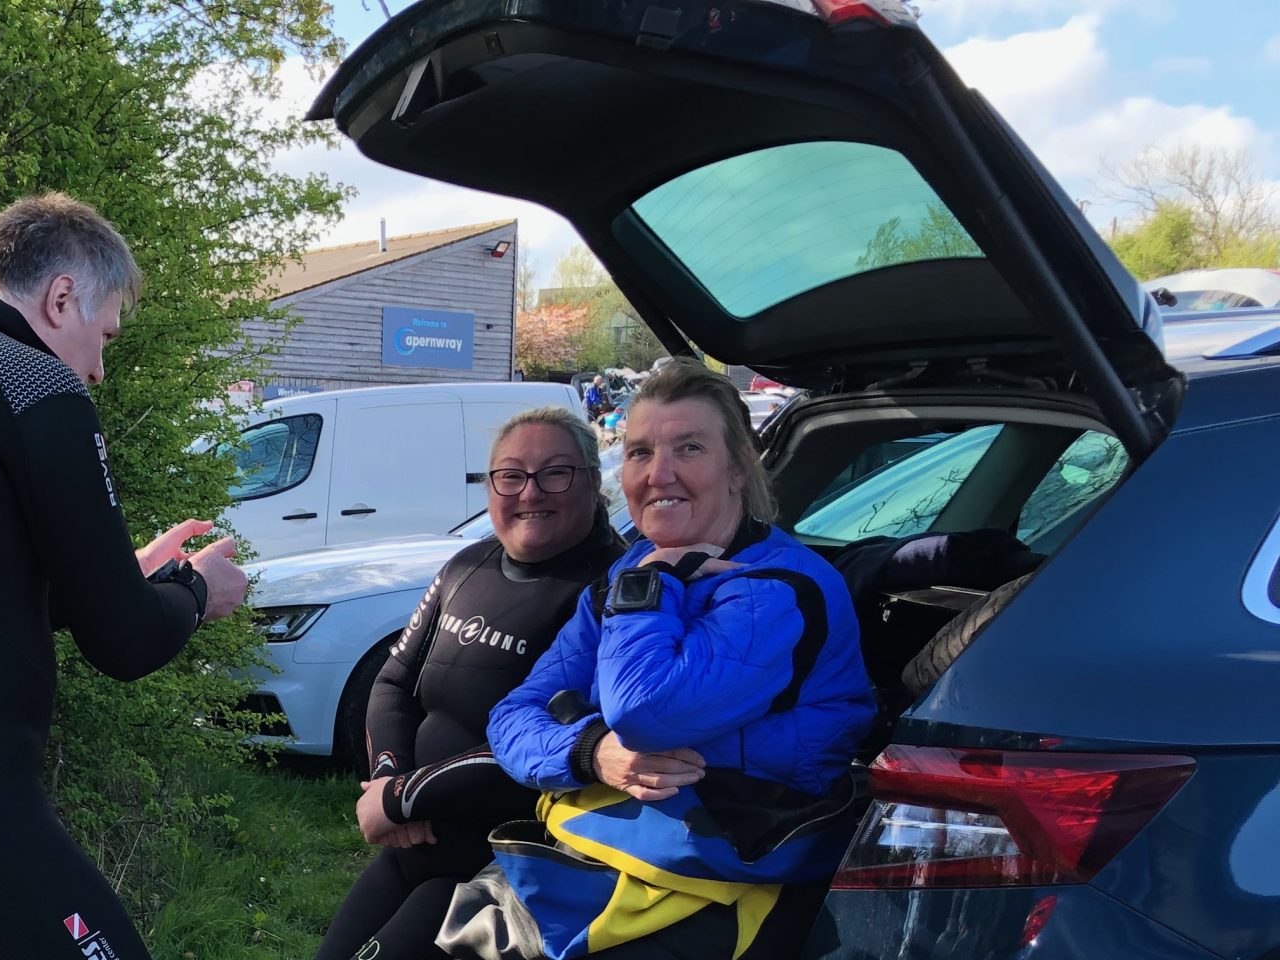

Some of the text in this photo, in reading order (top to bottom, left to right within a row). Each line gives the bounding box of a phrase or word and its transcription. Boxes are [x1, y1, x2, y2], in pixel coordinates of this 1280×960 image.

[412, 317, 440, 328] Welcome
[94, 432, 117, 507] ROVER
[479, 625, 528, 655] LUNG
[98, 936, 115, 960] center
